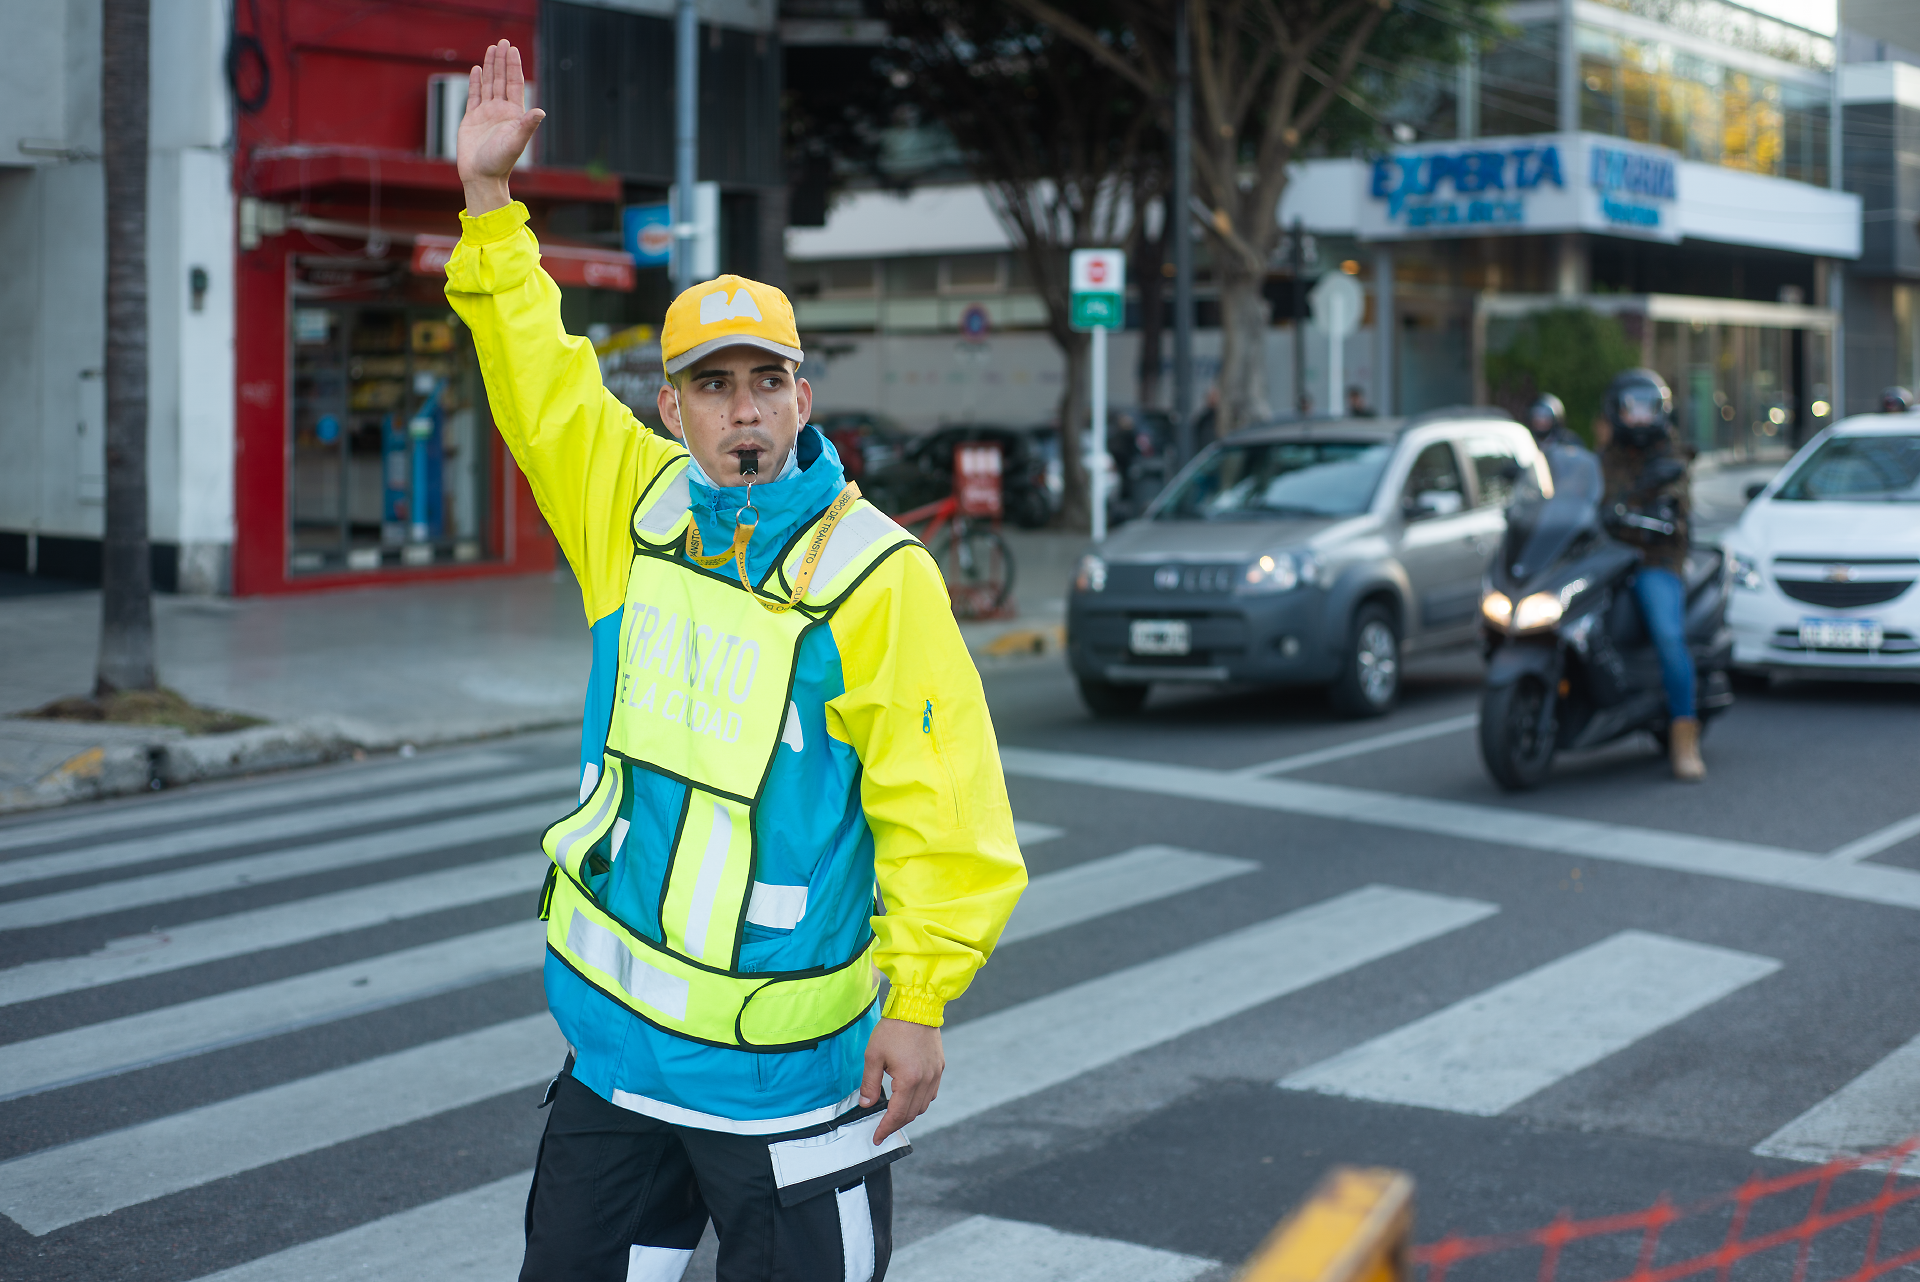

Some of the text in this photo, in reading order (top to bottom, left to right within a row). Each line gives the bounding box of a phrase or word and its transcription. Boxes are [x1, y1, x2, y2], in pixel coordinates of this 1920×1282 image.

[825, 512, 839, 522] DE
[625, 602, 760, 704] TRANSITO
[628, 677, 657, 713] LA
[662, 689, 742, 743] CIUDAD
